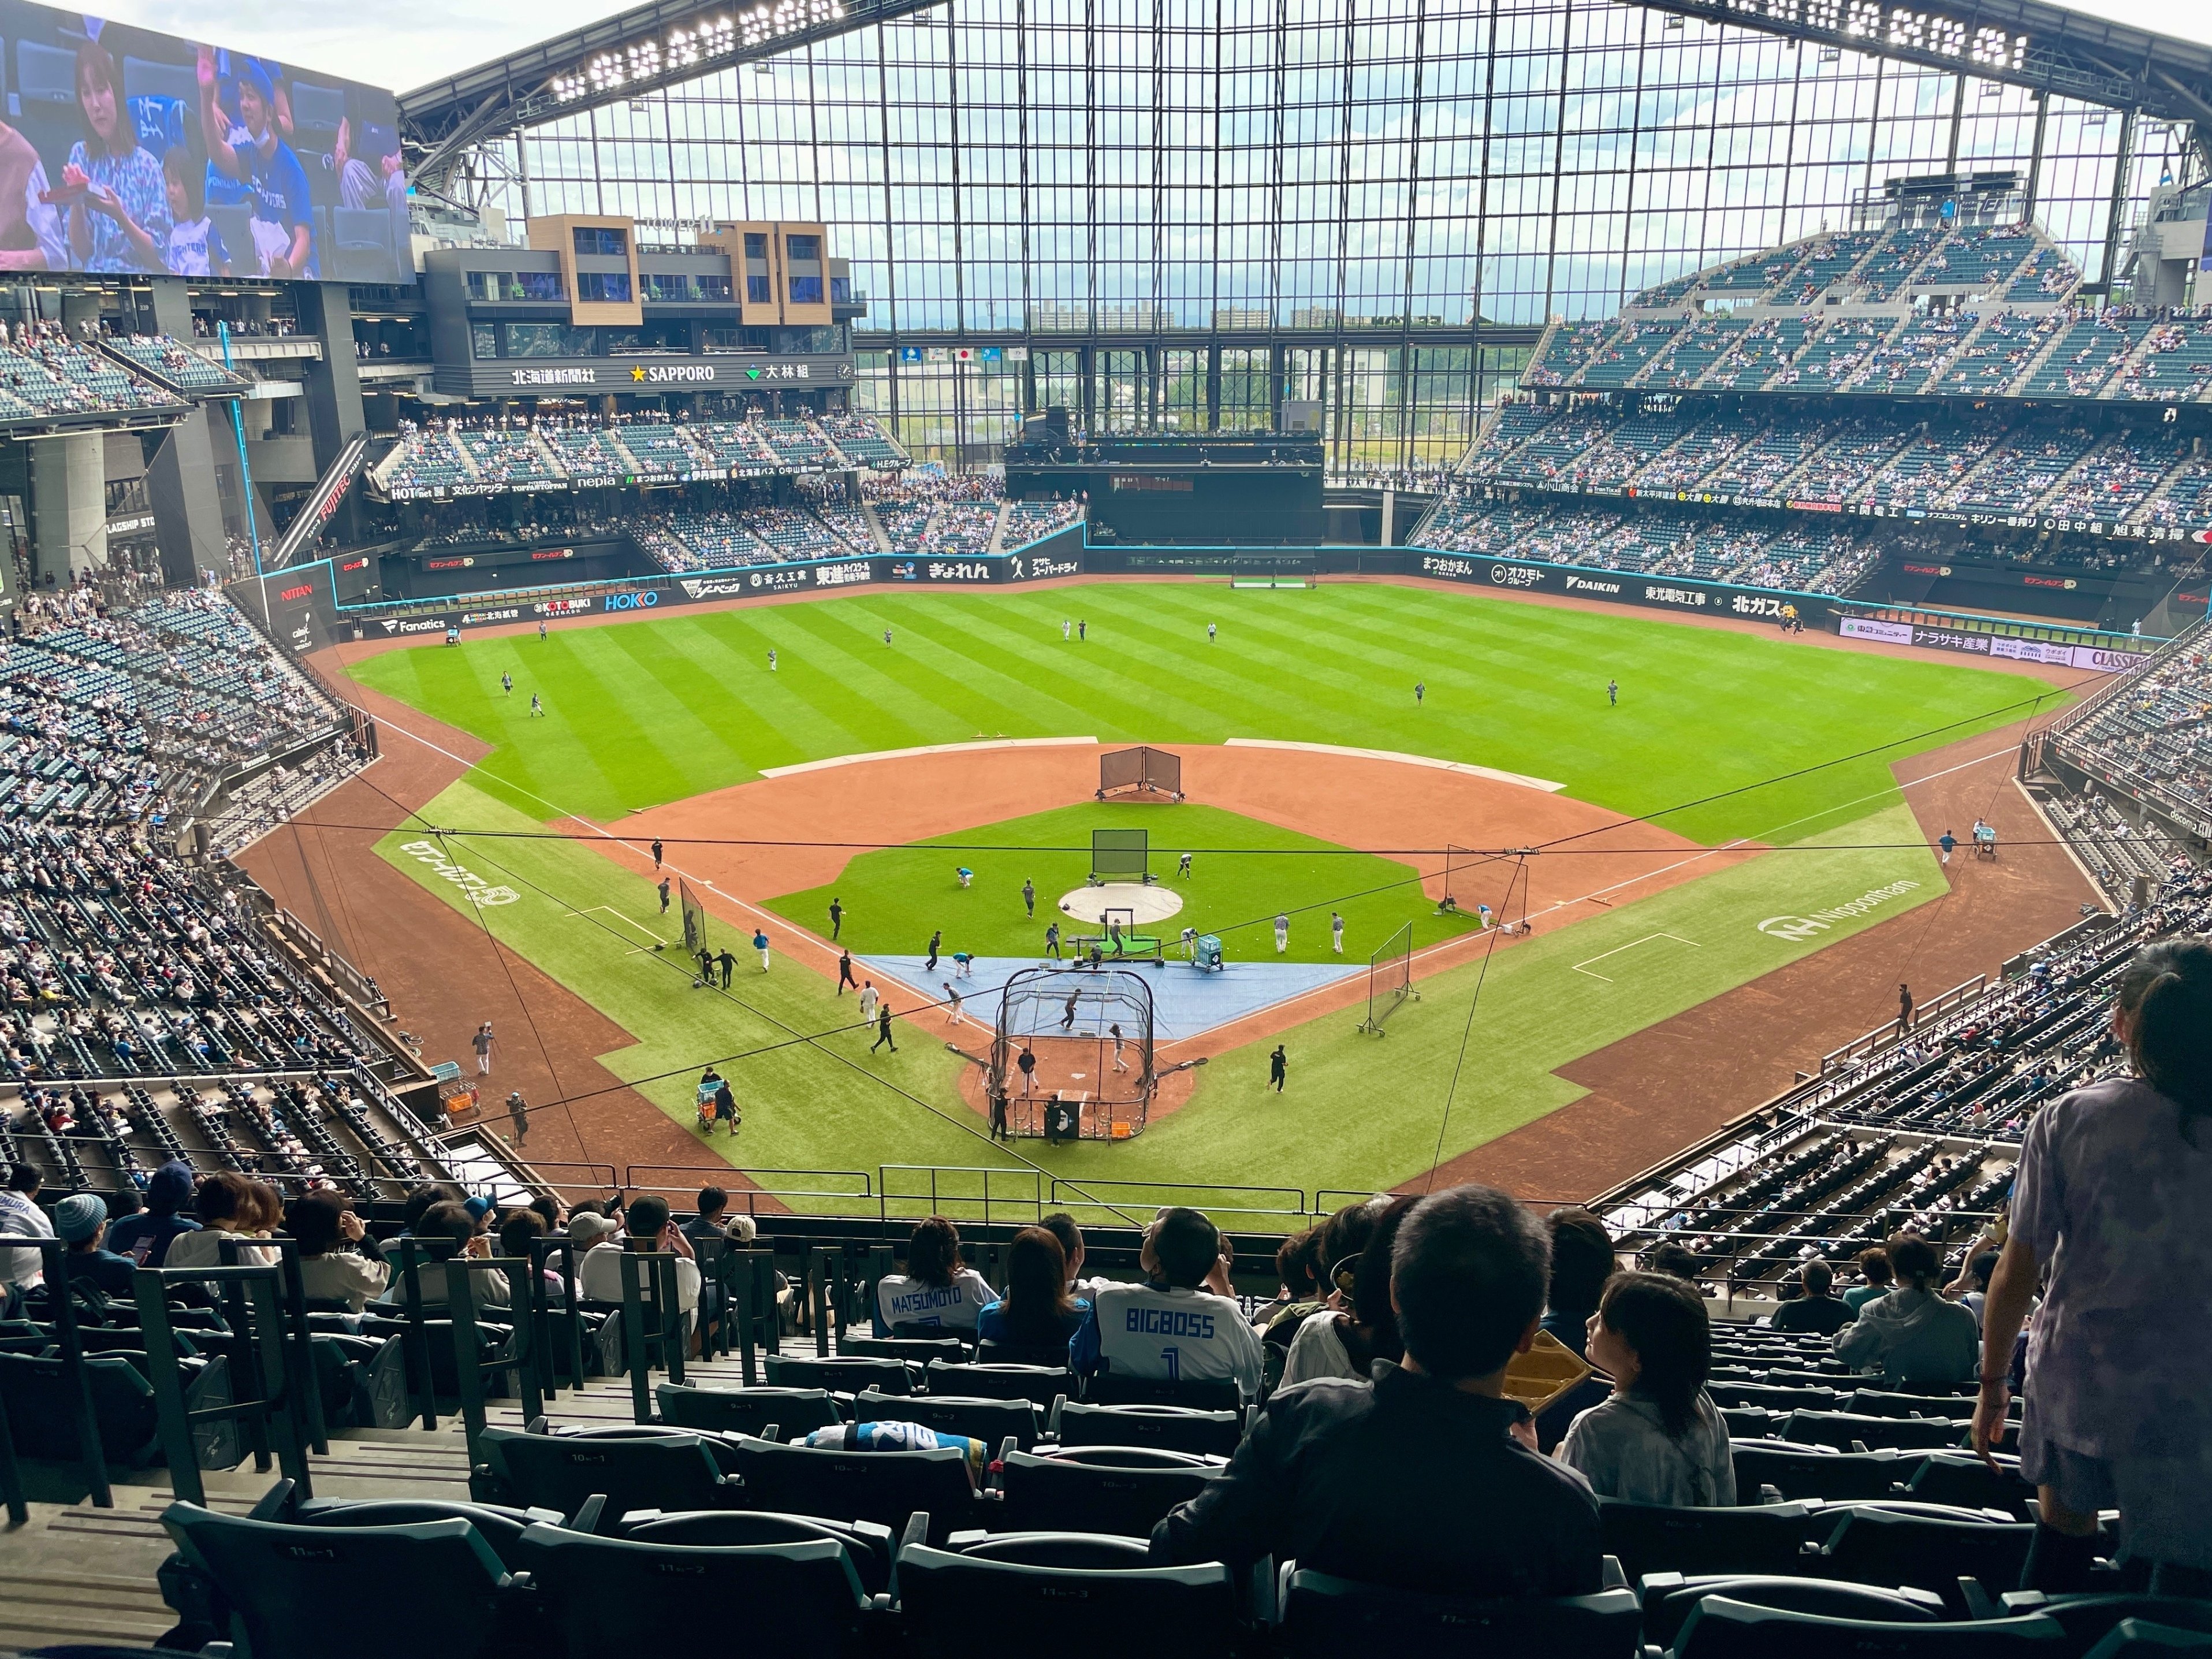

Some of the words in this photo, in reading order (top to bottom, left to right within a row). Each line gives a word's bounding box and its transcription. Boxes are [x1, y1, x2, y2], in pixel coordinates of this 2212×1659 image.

[644, 217, 697, 232] TOWER
[512, 368, 596, 385] 北海道新聞社
[649, 366, 715, 382] SAPPORO
[765, 364, 809, 379] 大林組
[636, 473, 676, 483] まつおかまん
[739, 467, 775, 477] 北海道バス
[578, 475, 616, 488] nepia
[1544, 481, 1579, 493] 小山商会
[320, 474, 351, 521] FUJITEC
[1971, 514, 2036, 528] キリン一番搾り
[2058, 519, 2103, 534] 田中組
[2112, 523, 2184, 541] 旭東清掃
[1032, 557, 1051, 566] アサヒ
[1032, 561, 1078, 576] スーパードライ
[1423, 556, 1473, 575] まつおかまん
[815, 565, 844, 586] 東進
[929, 563, 990, 579] ぎょれん
[1508, 567, 1545, 581] オカモト
[1507, 578, 1532, 586] グループ
[1577, 580, 1620, 593] DAIKIN
[281, 584, 312, 601] NITTAN
[1645, 586, 1706, 606] 東光電気工事
[543, 598, 591, 612] KOTOBUKI
[1732, 595, 1781, 618] 北ガス
[486, 609, 519, 620] 北海紙管
[400, 619, 445, 633] Fanatics
[1915, 630, 1989, 652] ナラサキ産業
[241, 752, 271, 770] Panasonic
[1808, 880, 1921, 923] Nipponham
[891, 1286, 962, 1315] MATSUMOTO
[1126, 1307, 1214, 1340] BIGBOSS
[1160, 1347, 1179, 1381] 1
